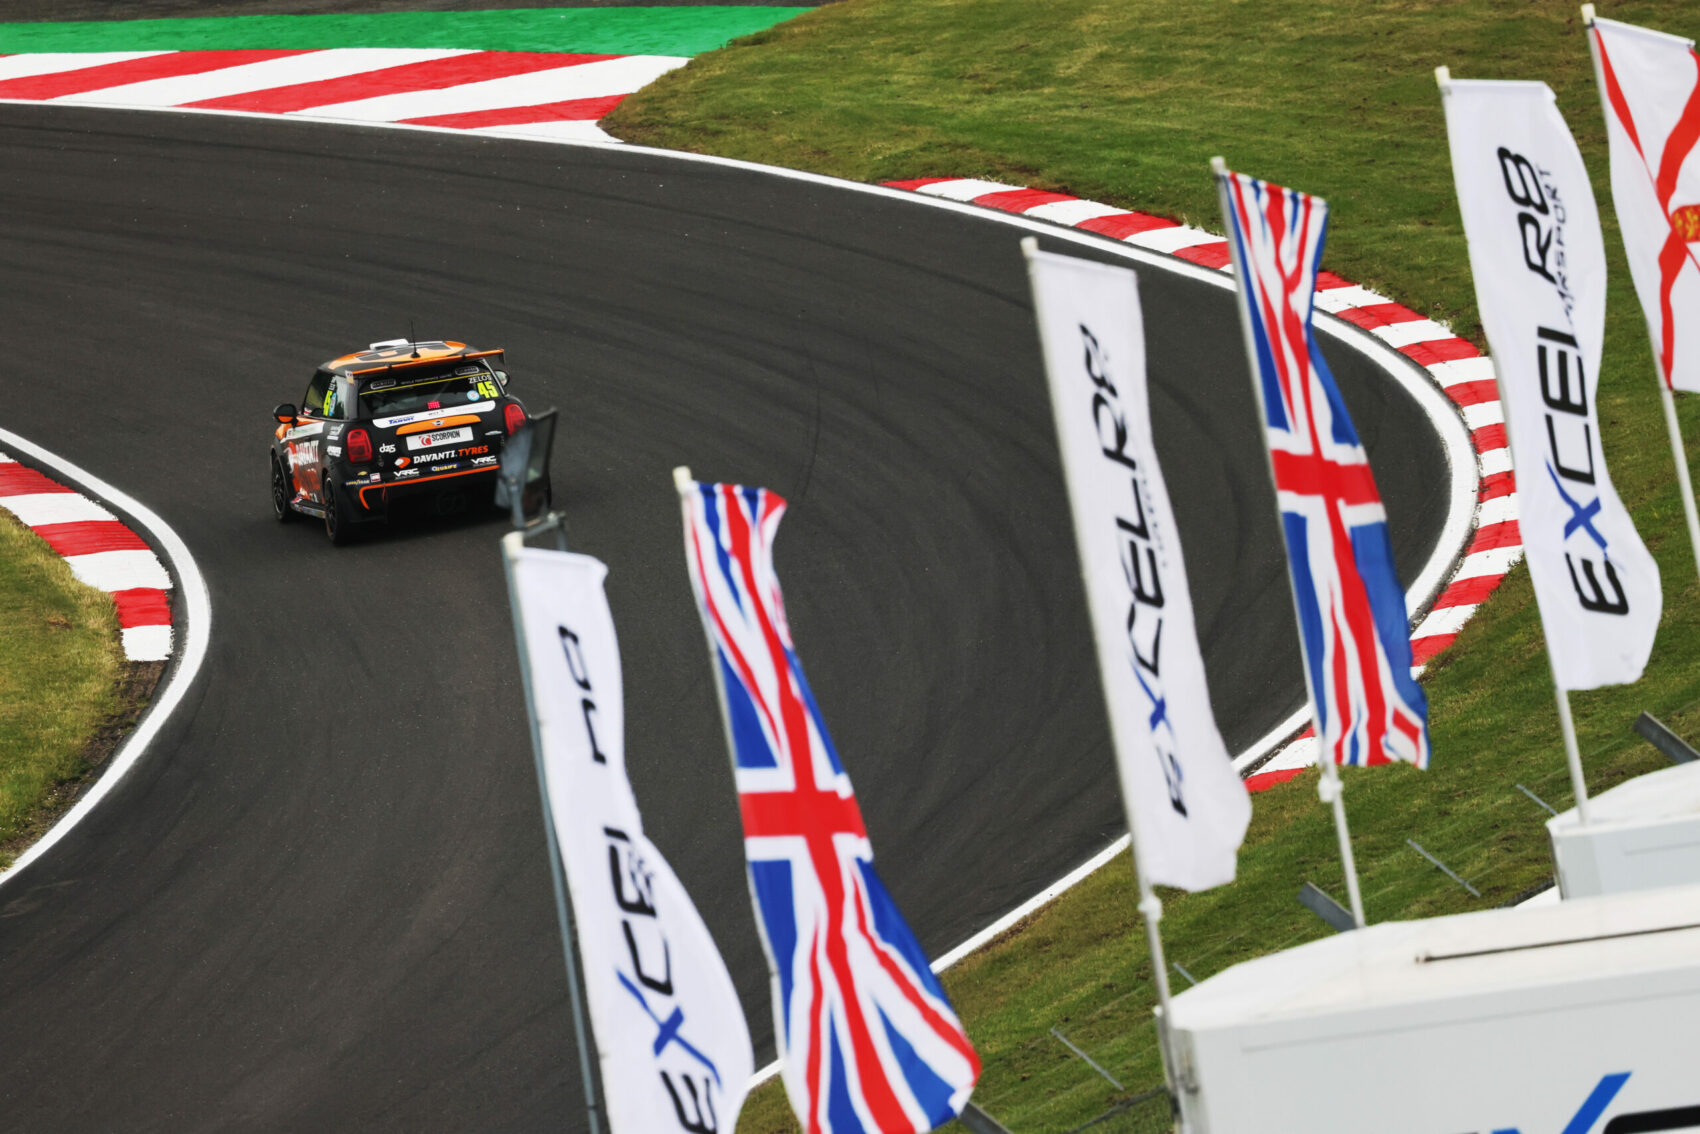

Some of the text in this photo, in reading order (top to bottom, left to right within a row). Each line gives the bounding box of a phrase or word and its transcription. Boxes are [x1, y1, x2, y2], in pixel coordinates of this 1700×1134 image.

[468, 374, 492, 384] ZELOS
[477, 380, 499, 398] 45
[431, 430, 461, 442] SCORPION
[413, 444, 489, 464] DAVANTI TYRES
